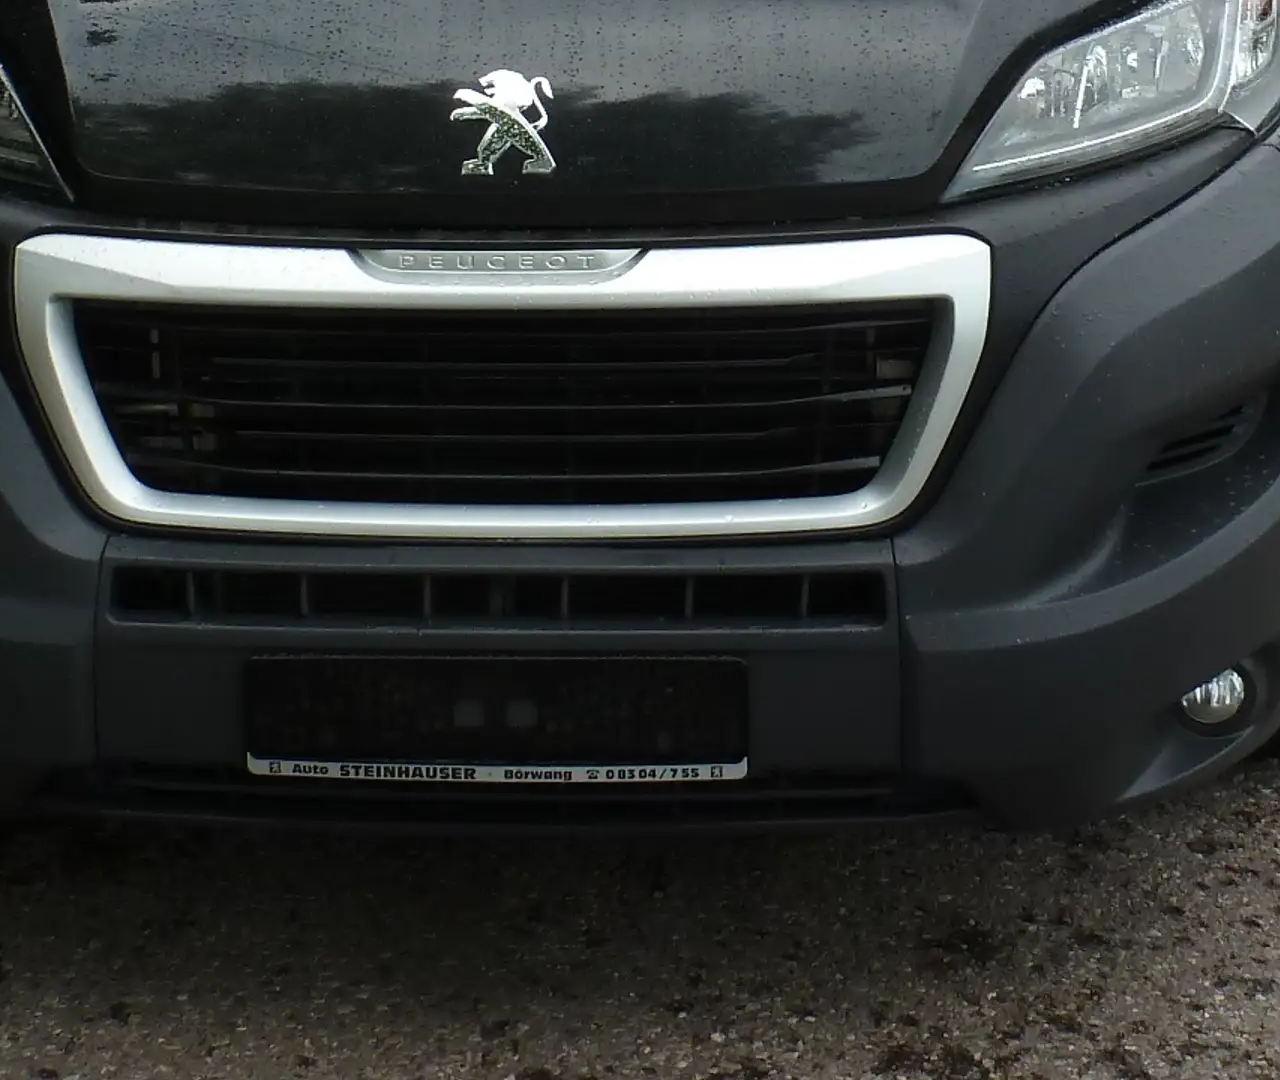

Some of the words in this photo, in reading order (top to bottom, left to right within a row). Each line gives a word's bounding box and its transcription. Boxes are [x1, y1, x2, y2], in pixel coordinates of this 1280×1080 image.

[399, 255, 596, 269] PEUGEOT
[291, 763, 329, 776] Auto
[339, 764, 476, 780] STEINHAUSER
